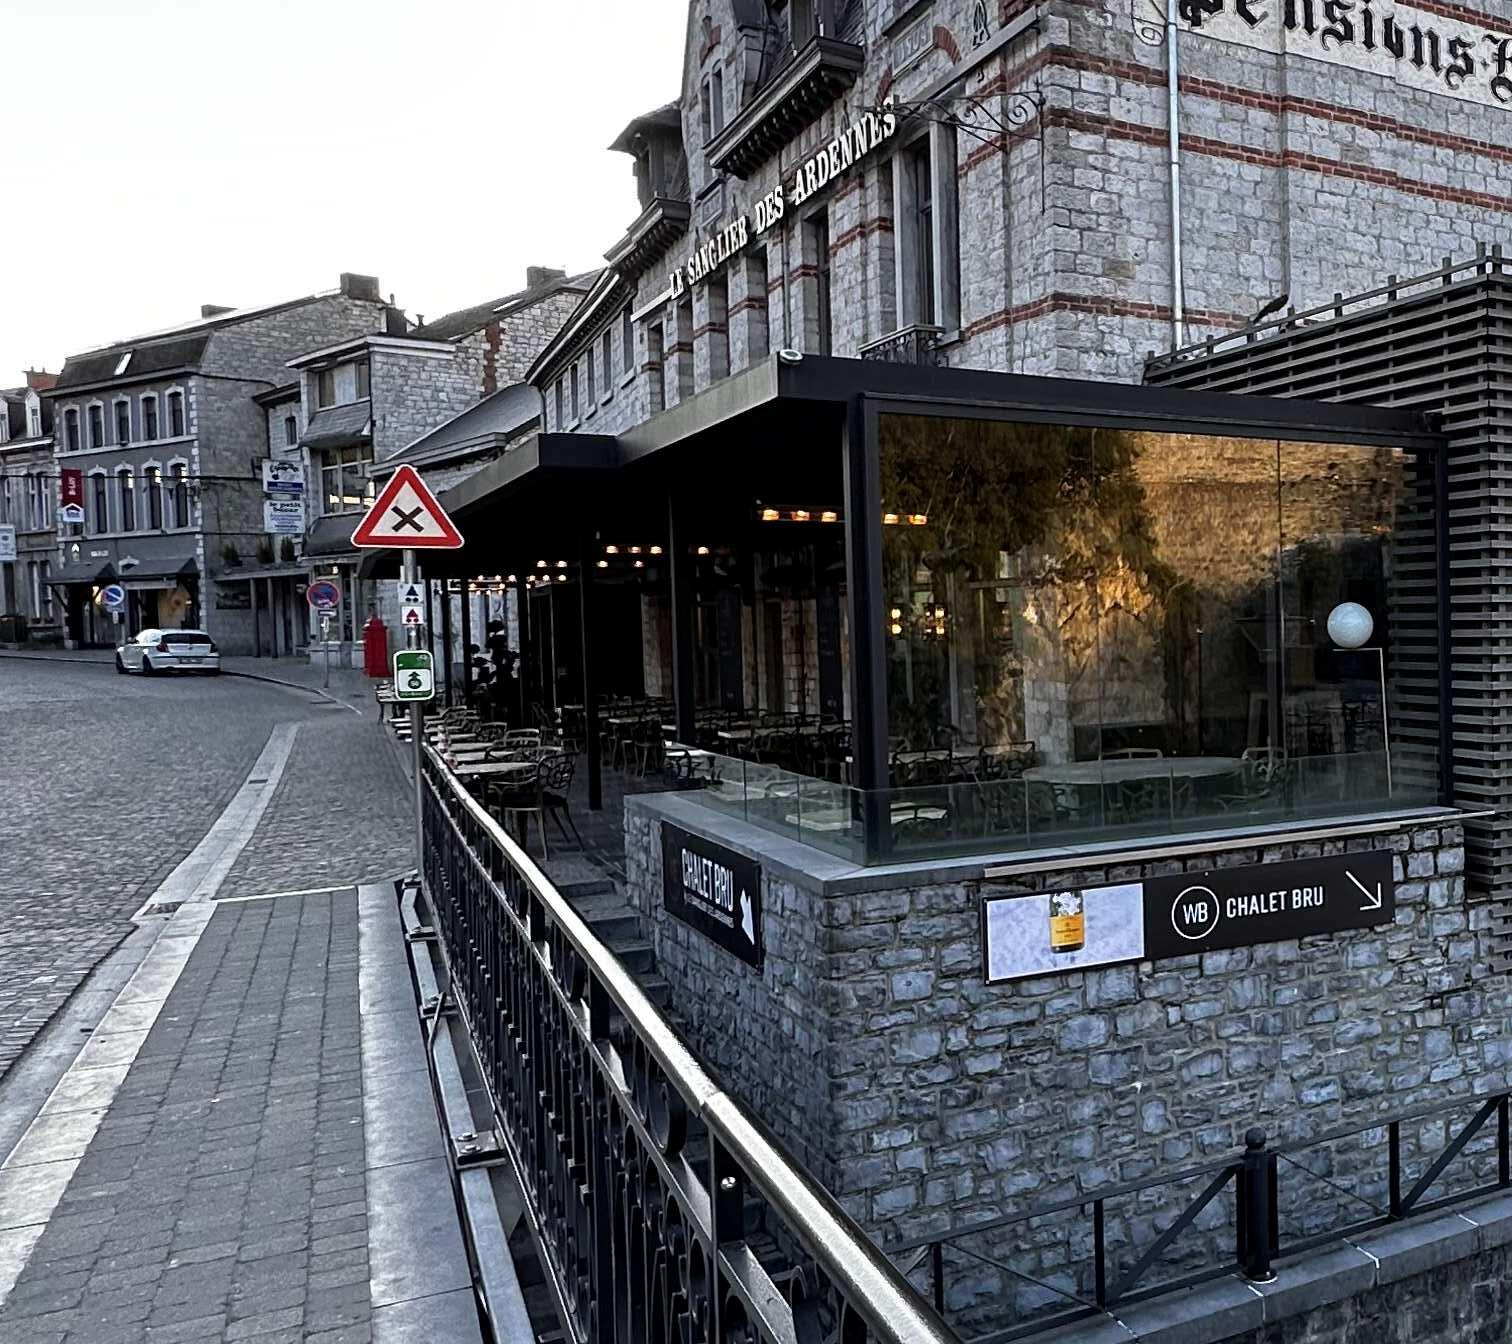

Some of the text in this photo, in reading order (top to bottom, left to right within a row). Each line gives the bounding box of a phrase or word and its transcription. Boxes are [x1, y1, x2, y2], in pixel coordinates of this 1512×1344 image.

[670, 97, 896, 299] LE SANGLIER DES ARDENNES
[682, 848, 712, 900] CHALET
[714, 863, 734, 912] BRU
[1183, 886, 1324, 925] WB CHALET BRU
